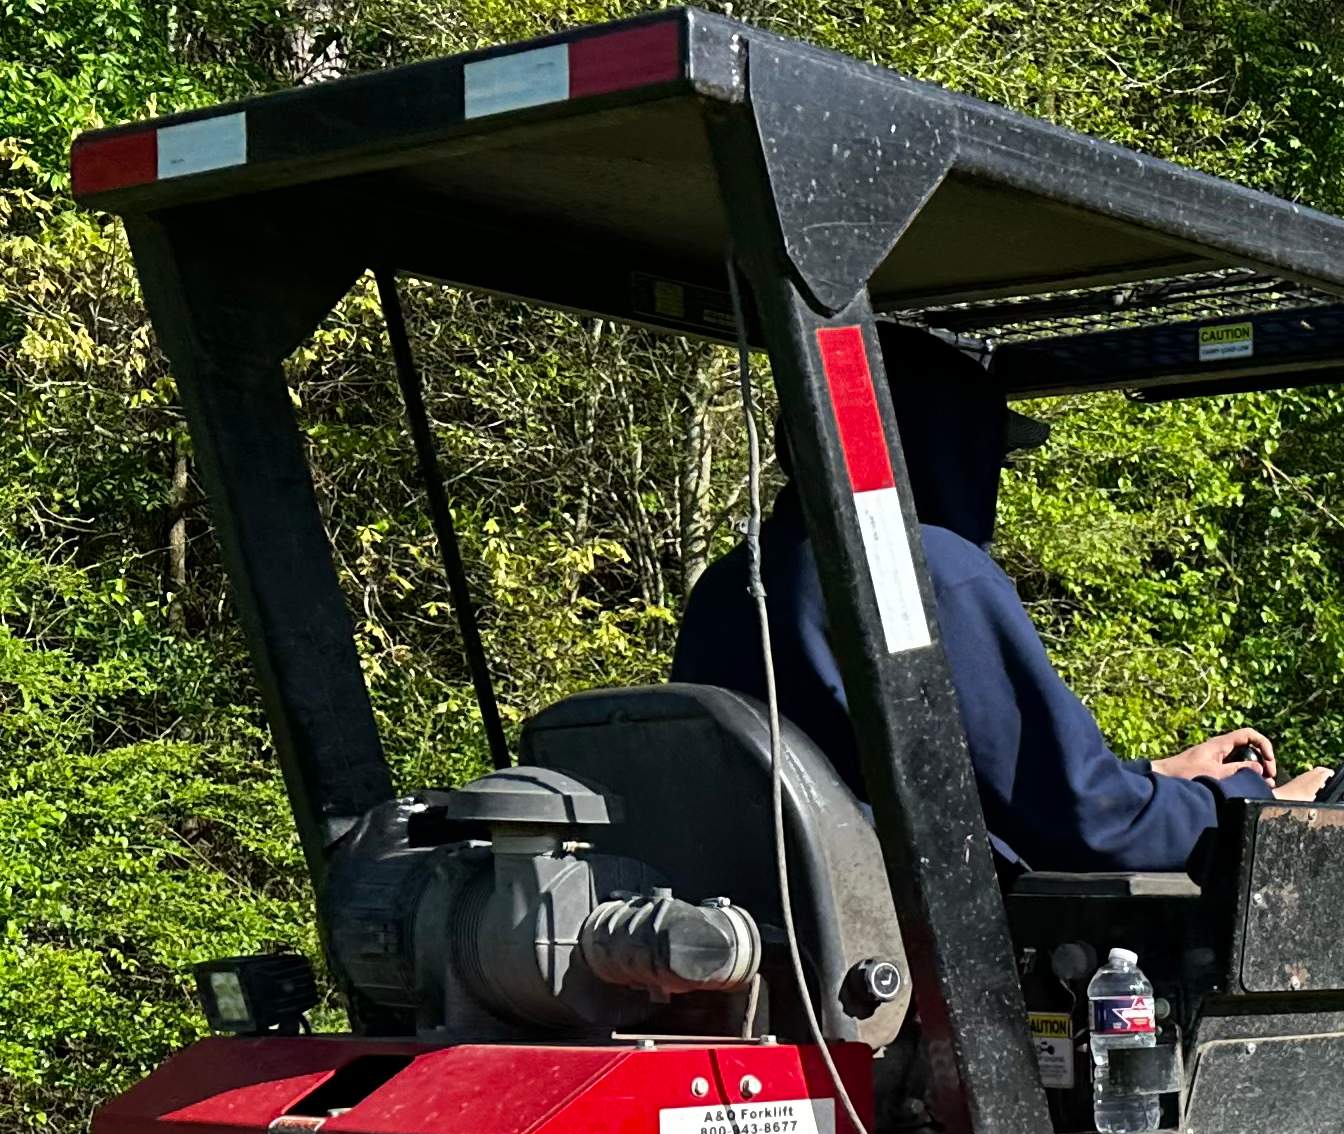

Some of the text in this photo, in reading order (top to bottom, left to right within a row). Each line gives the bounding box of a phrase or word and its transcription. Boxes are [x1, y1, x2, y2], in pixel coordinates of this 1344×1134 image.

[1201, 326, 1250, 342] CAUTION
[1030, 1018, 1067, 1034] AUTION
[741, 1106, 793, 1120] Forklift
